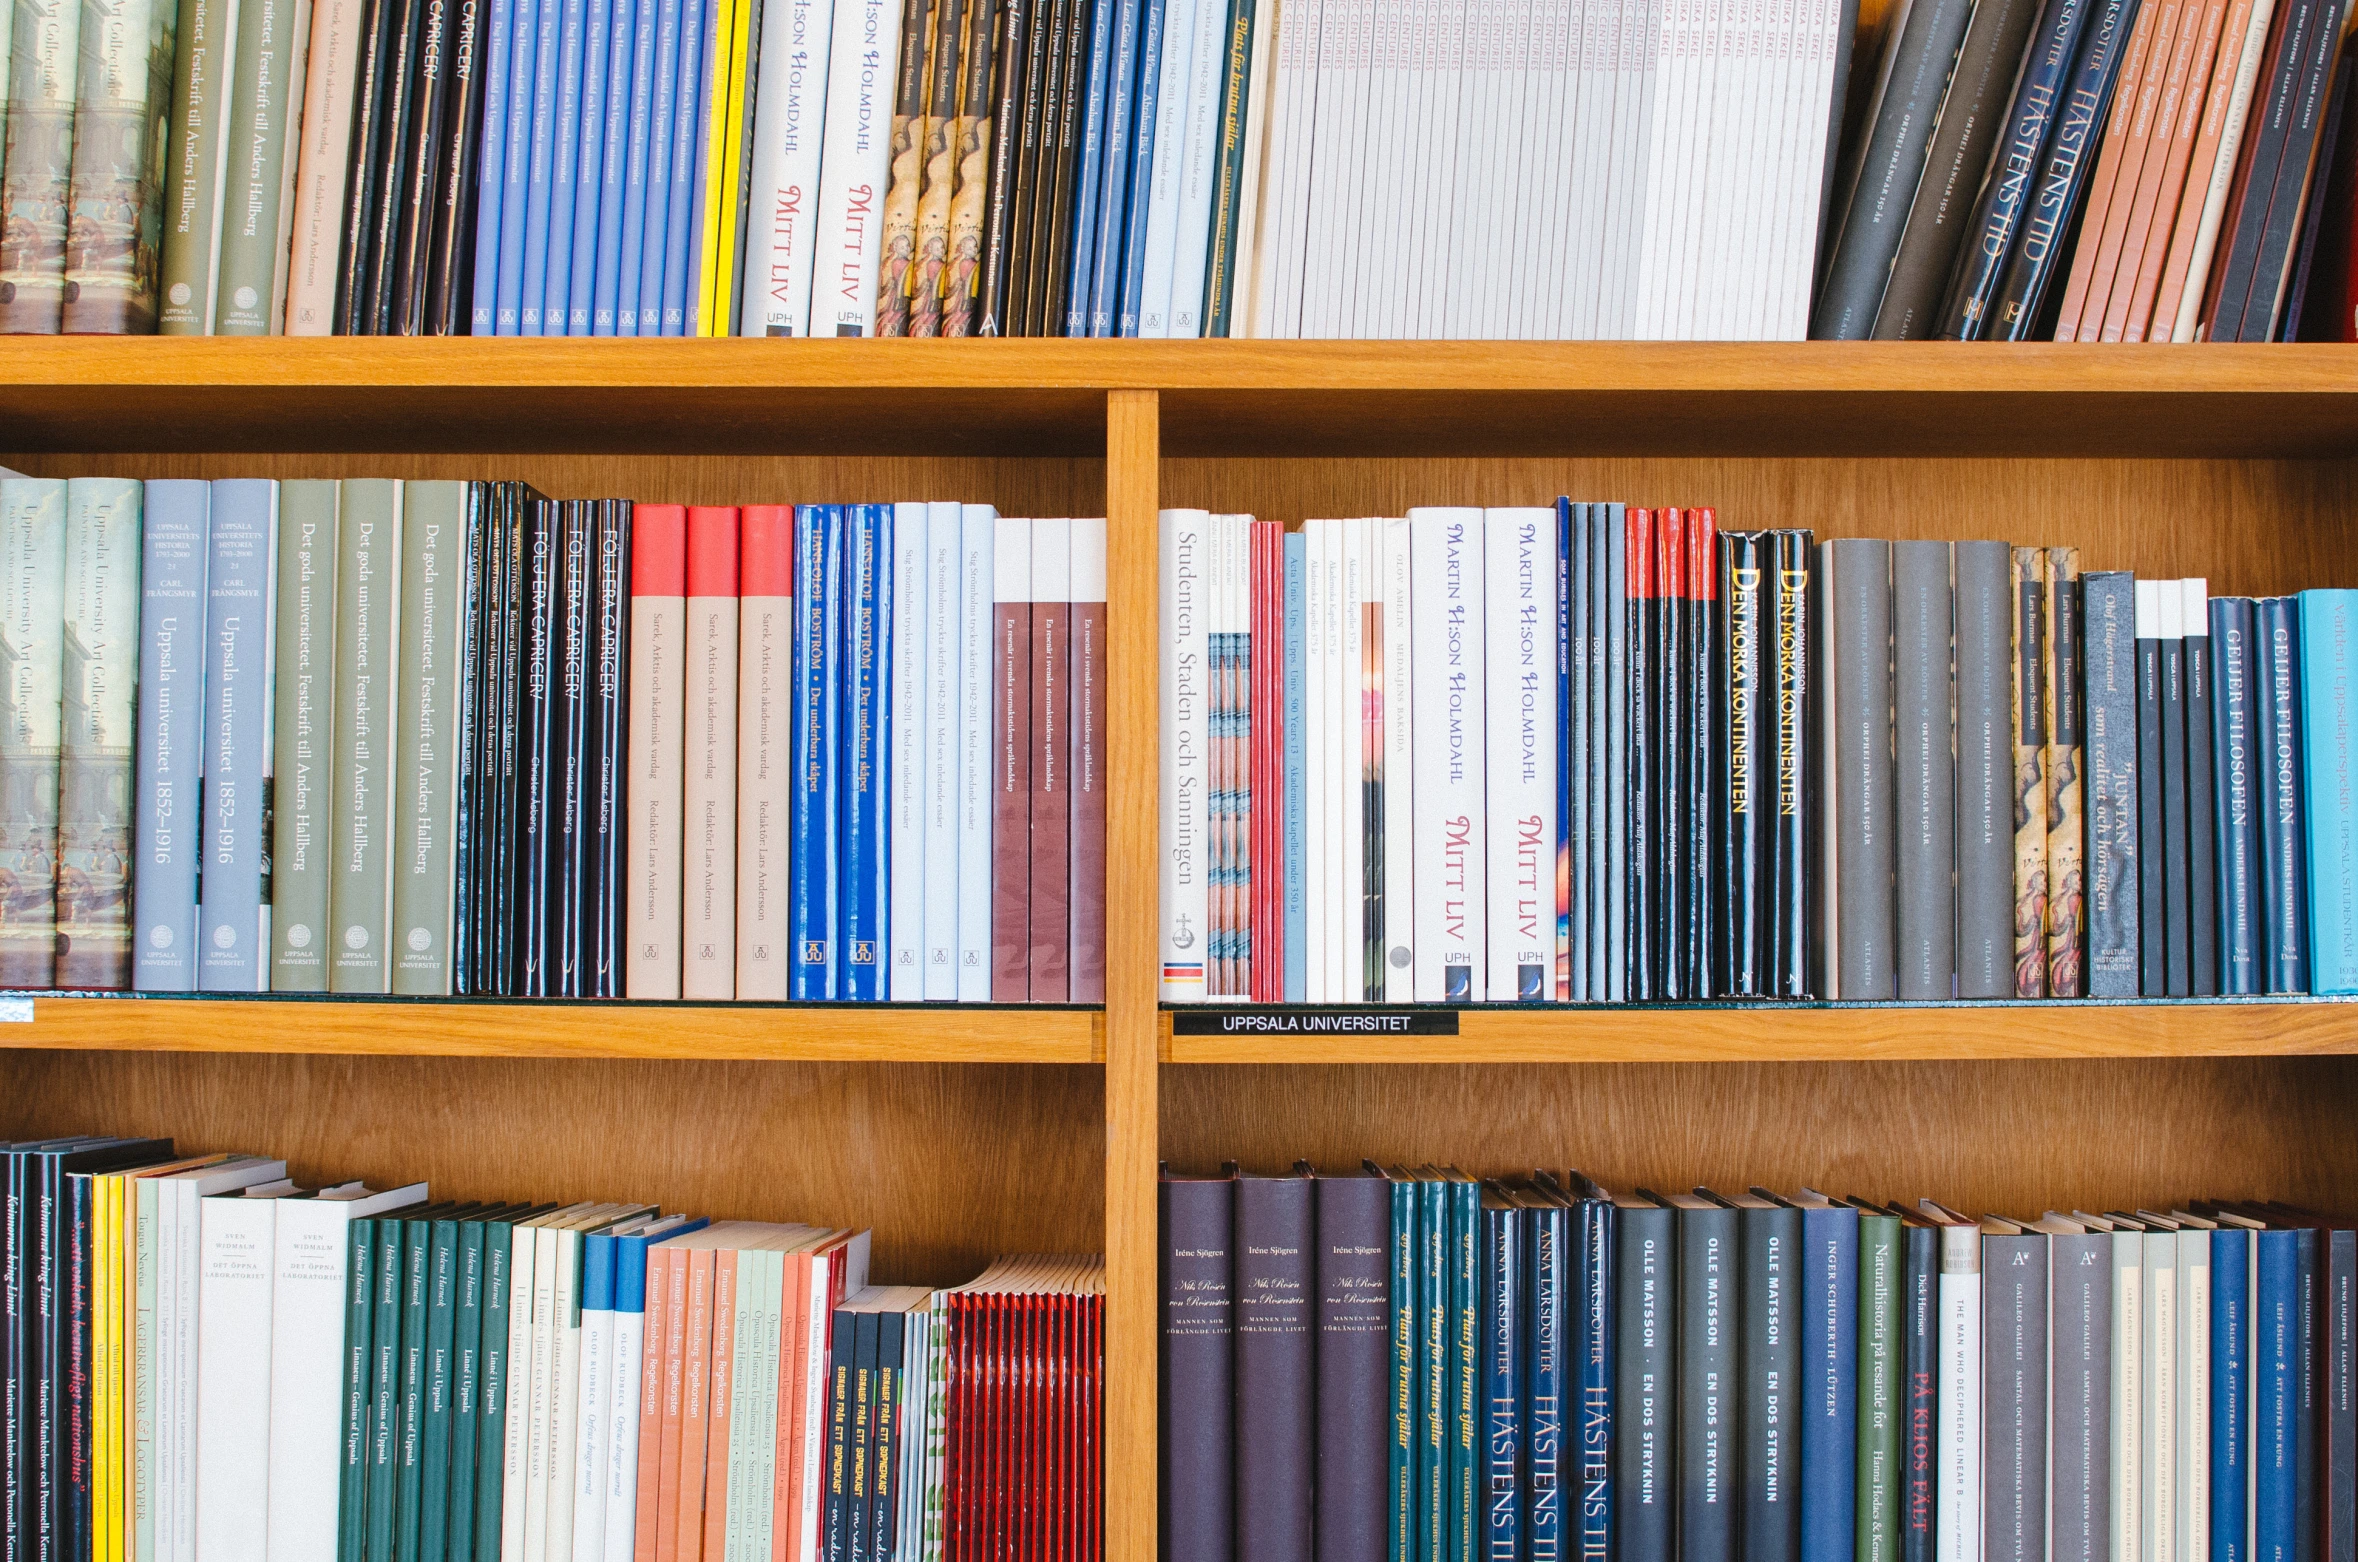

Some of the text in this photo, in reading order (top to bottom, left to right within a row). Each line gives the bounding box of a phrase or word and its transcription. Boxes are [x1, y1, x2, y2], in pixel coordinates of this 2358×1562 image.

[678, 20, 697, 183] Dag Hammarskjöld och Uppsala universitet
[1224, 17, 1249, 151] Plats för brutna själar
[2302, 5, 2336, 130] BRUNO LILJEFORS ALLAN ELLENIUS
[178, 47, 206, 233] Festskrift till Anders Hallberg
[840, 50, 880, 302] HOLMDAHL MITT LIV
[987, 98, 1012, 287] Mariette Manktelow och Petronella Kettunen
[1872, 114, 1912, 224] ORPHEI DRÄNGAR 150 ÅR
[1982, 84, 2054, 258] HÄSTENS TID
[838, 312, 862, 323] UPH
[600, 530, 620, 698] FÖLJ ERA CAPRICER!
[808, 529, 824, 792] HANS-OLOF BOSTRÖM Det underbara skåpet
[2062, 594, 2072, 730] Lars Burman Eloquent Students
[2104, 594, 2117, 692] Olof Hägerstrand
[156, 617, 178, 864] Uppsala universitet 1852–1916
[293, 523, 316, 872] Det goda universitetet. Festskrift till Anders Hallberg
[1172, 531, 1198, 885] Studenten, Staden och Sanningen
[1444, 523, 1470, 941] MARTIN H:SON HOLMDAHL MITT LIV
[1780, 570, 1808, 815] DEN MÖRKA KONTINENTEN
[598, 756, 612, 834] Christer Åsberg
[1921, 816, 1930, 830] 150
[1922, 763, 1931, 814] DRÄNGAR
[1922, 831, 1931, 844] ÅR
[2094, 706, 2112, 912] som realitet och hörsägen
[2273, 628, 2294, 933] GEIJER FILOSOFEN ANDERS LUNDAHL
[1223, 1016, 1411, 1031] UPPSALA UNIVERSITET
[1444, 952, 1470, 962] UPH
[37, 1194, 52, 1318] Kvinnorna kring Linné
[1249, 1246, 1298, 1256] Iréne Sjögren
[1956, 1299, 1964, 1318] THE
[2082, 1282, 2091, 1360] GALILEO GALILEI
[406, 1246, 422, 1466] Helena Harnesk Linnaeus Genius of Uppsala
[716, 1268, 731, 1418] Emanuel Swedenborg Regelkonsten
[881, 1366, 892, 1400] SIGNALER
[1533, 1228, 1560, 1526] ANNA LARSDOTTER HÄSTENS
[1706, 1238, 1718, 1503] OLLE MATSSON EN DOS STRYKNIN
[1826, 1240, 1838, 1416] INGER SCHUBERTH LÜTZEN
[1872, 1244, 1889, 1428] Naturalhistoria på resande fot
[1956, 1323, 1964, 1346] MAN
[1956, 1350, 1964, 1374] WHO
[2275, 1302, 2284, 1468] LEIF ÅSLUND ATT FOSTRA EN KUNG
[136, 1306, 151, 1520] LAGERKRANSAR & LOGOTYPER
[880, 1403, 892, 1424] FRÅN
[880, 1426, 890, 1442] ETT
[1912, 1274, 1934, 1532] Dick Harrison PÅ KLIOS FÄLT
[1956, 1378, 1964, 1444] DECIPHERED
[1956, 1448, 1964, 1486] LINEAR
